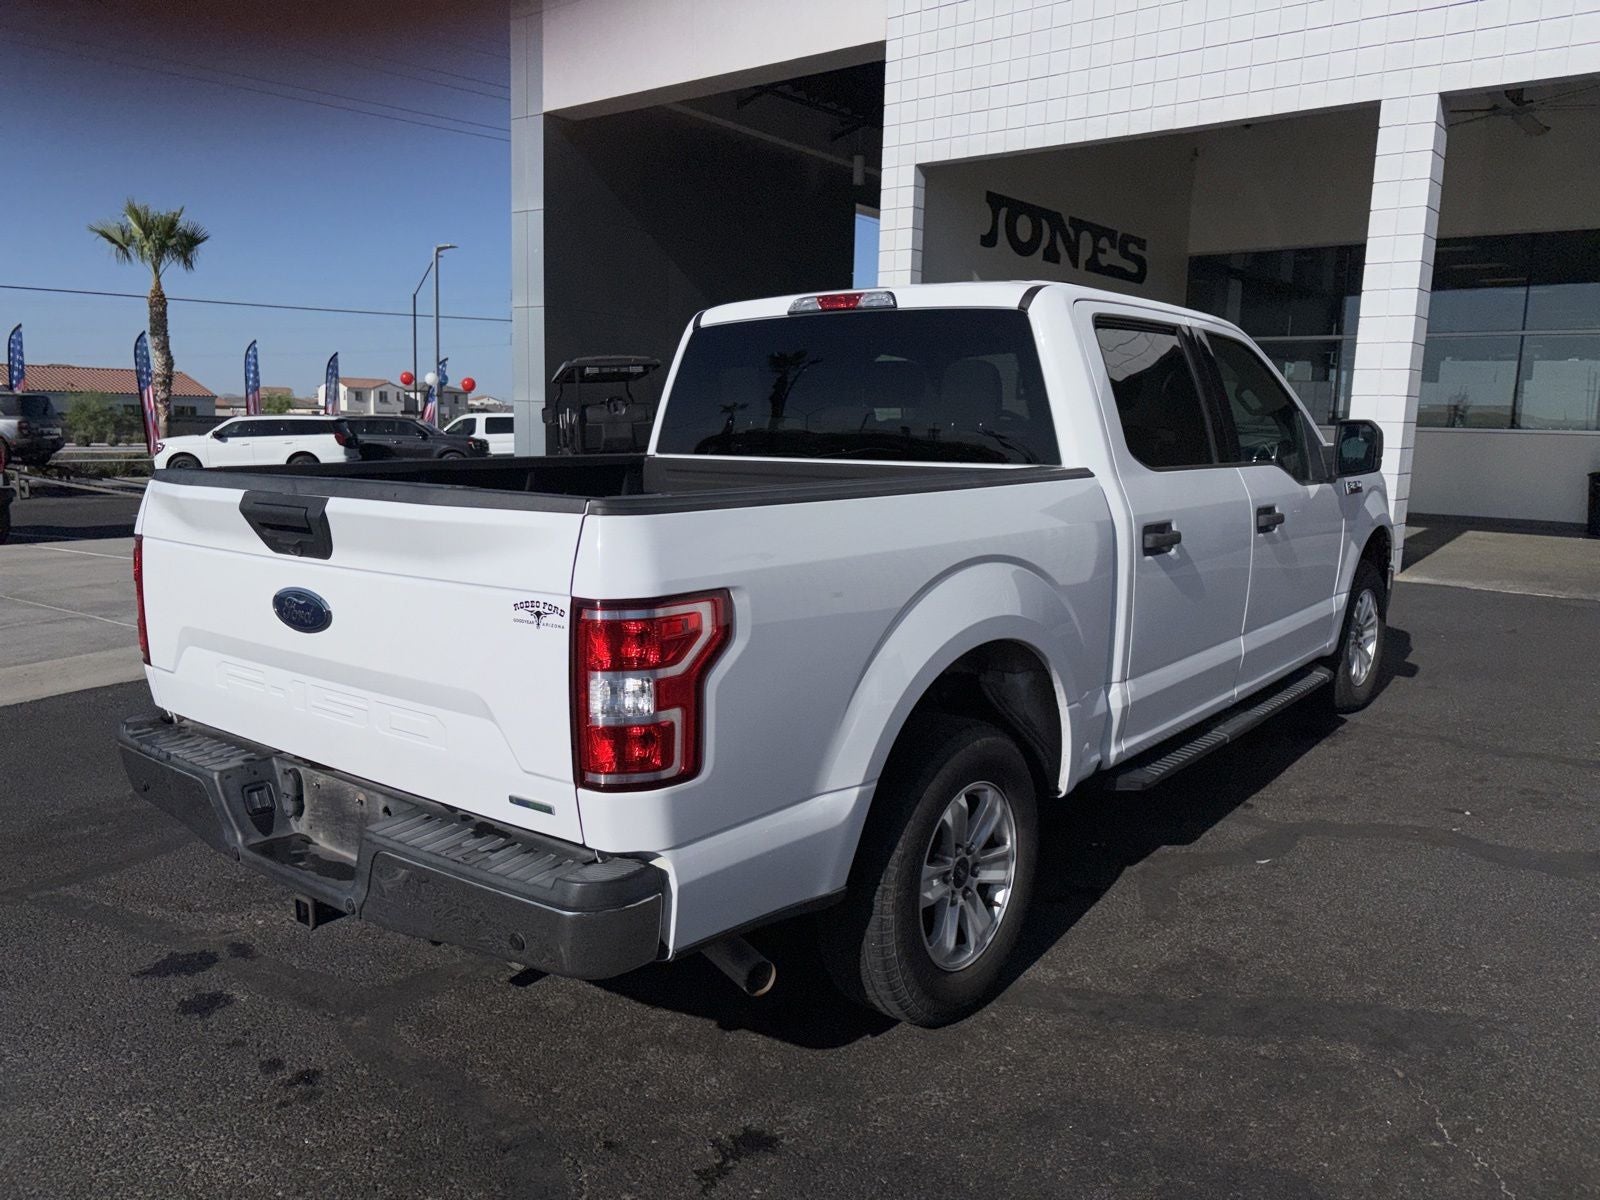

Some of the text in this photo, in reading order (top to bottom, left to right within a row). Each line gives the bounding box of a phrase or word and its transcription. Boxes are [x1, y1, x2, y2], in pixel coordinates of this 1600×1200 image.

[980, 190, 1148, 285] JONES
[513, 600, 566, 617] RODEO FORD
